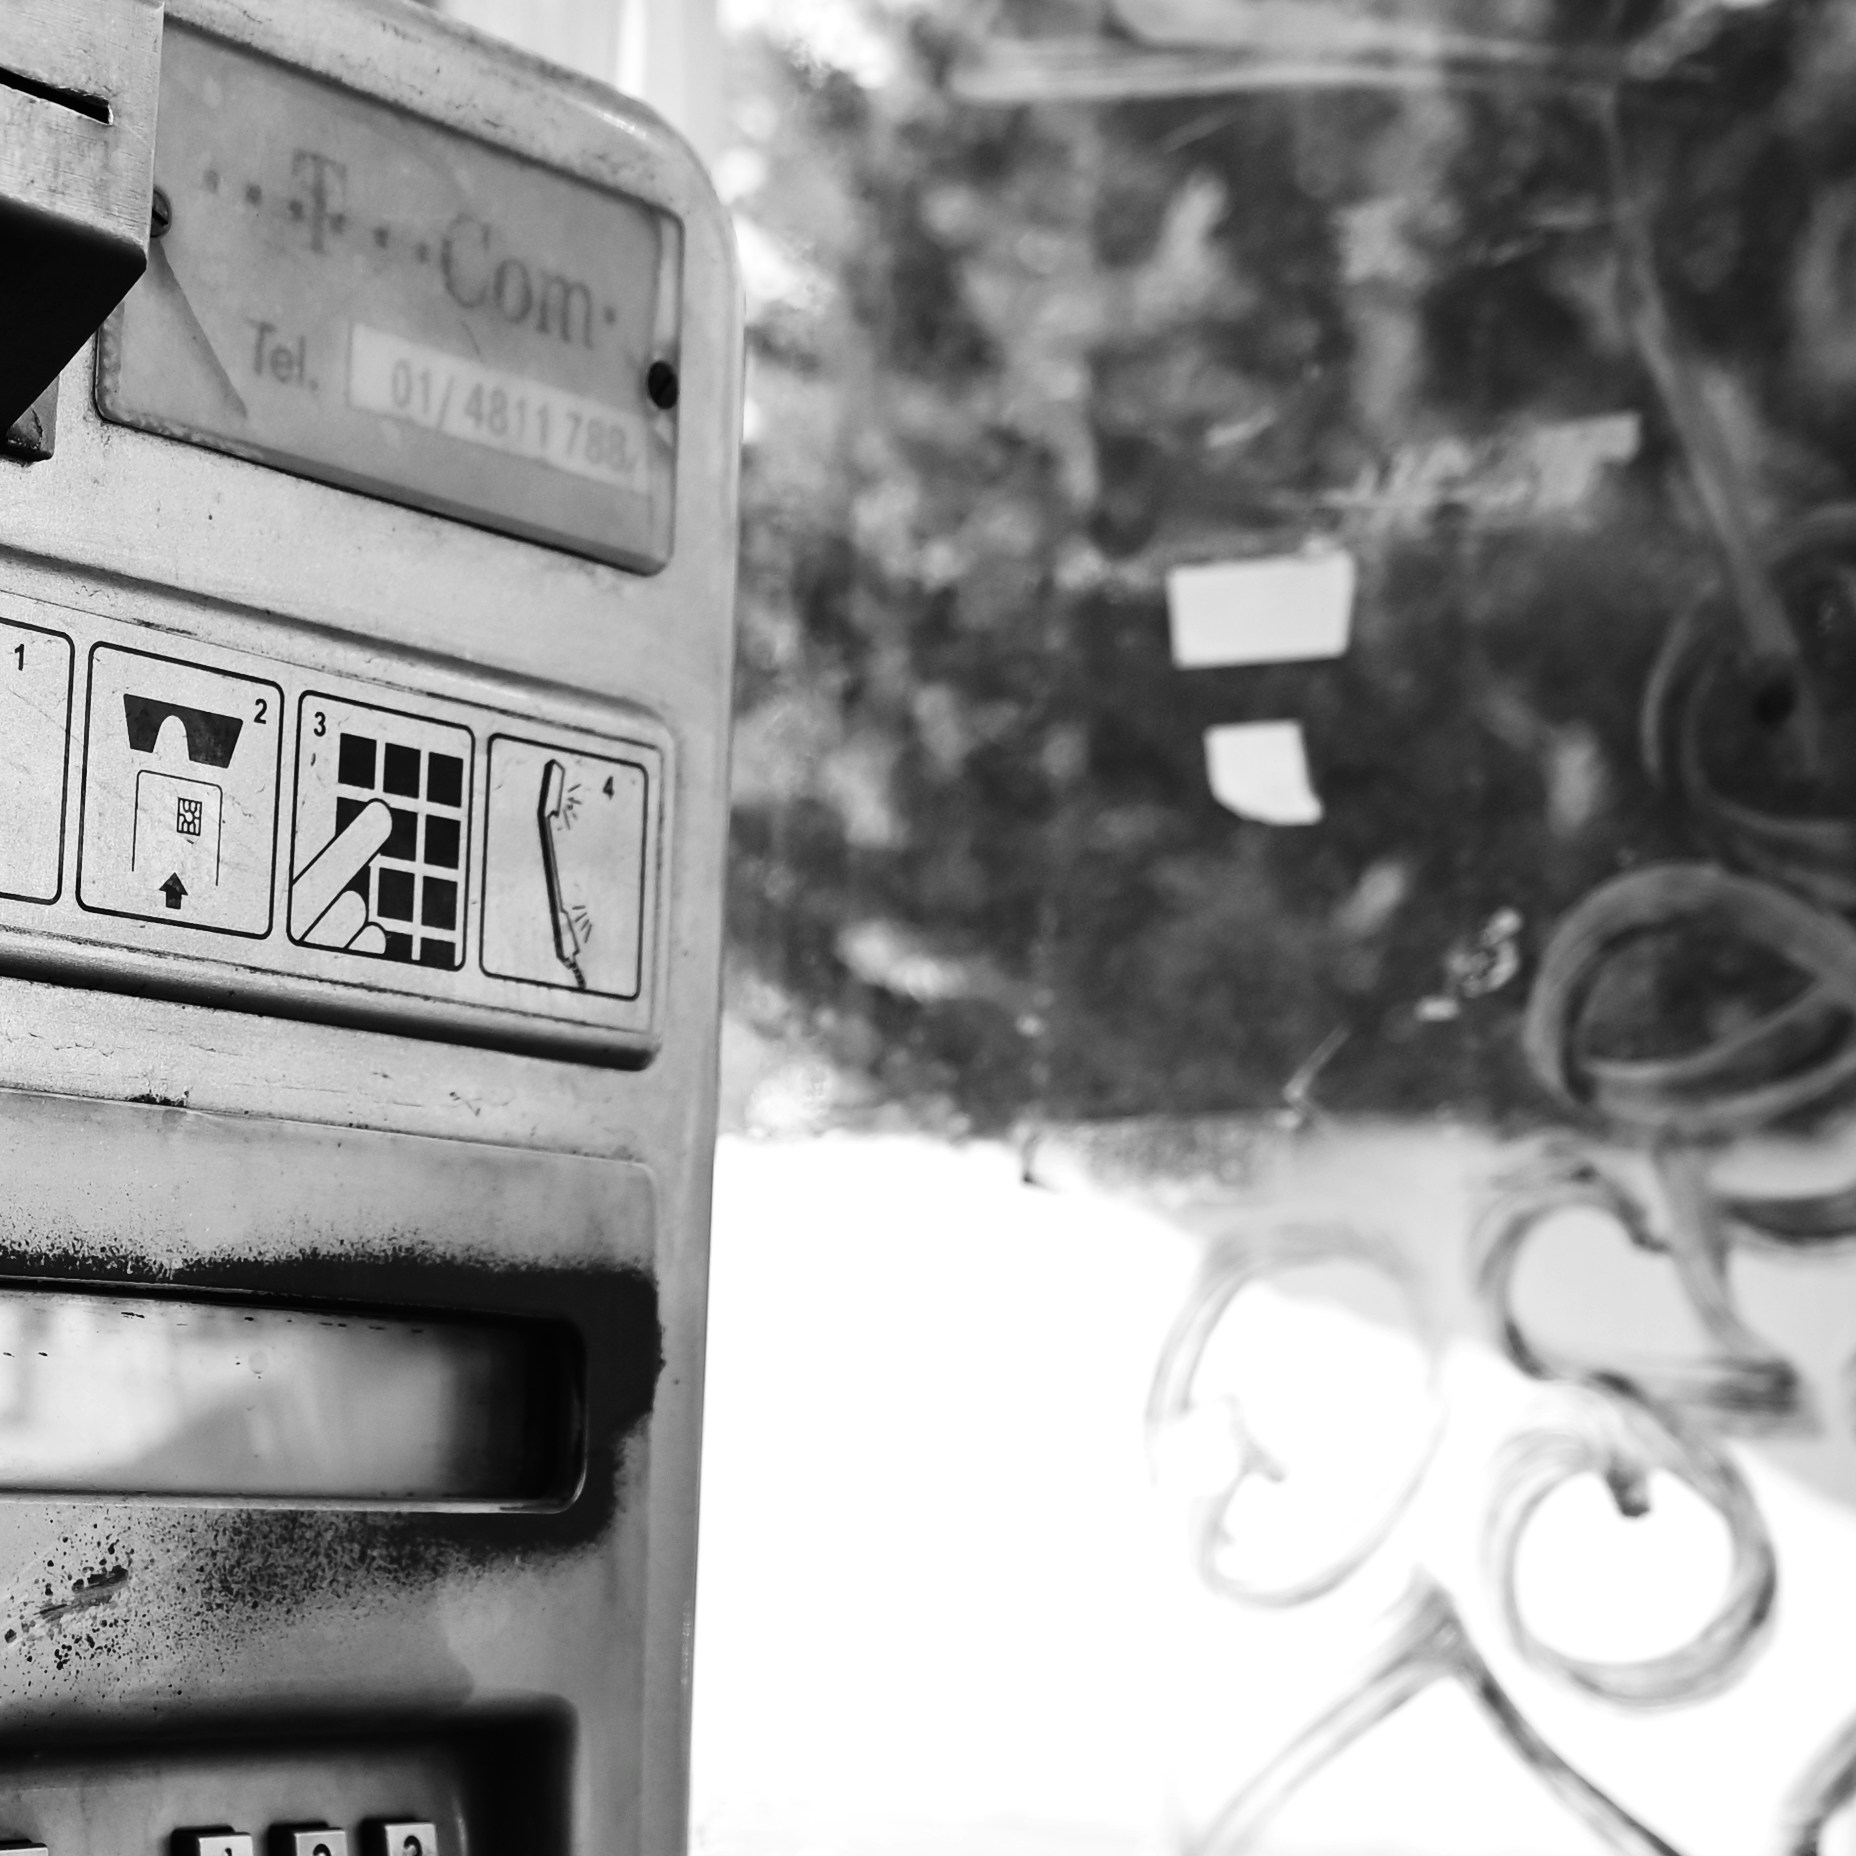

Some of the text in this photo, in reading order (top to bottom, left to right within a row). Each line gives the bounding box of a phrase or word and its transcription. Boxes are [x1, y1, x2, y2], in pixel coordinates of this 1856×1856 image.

[249, 317, 319, 392] Tel.
[15, 644, 24, 670] 1
[254, 699, 267, 724] 2
[314, 712, 326, 736] 3
[603, 777, 613, 797] 4
